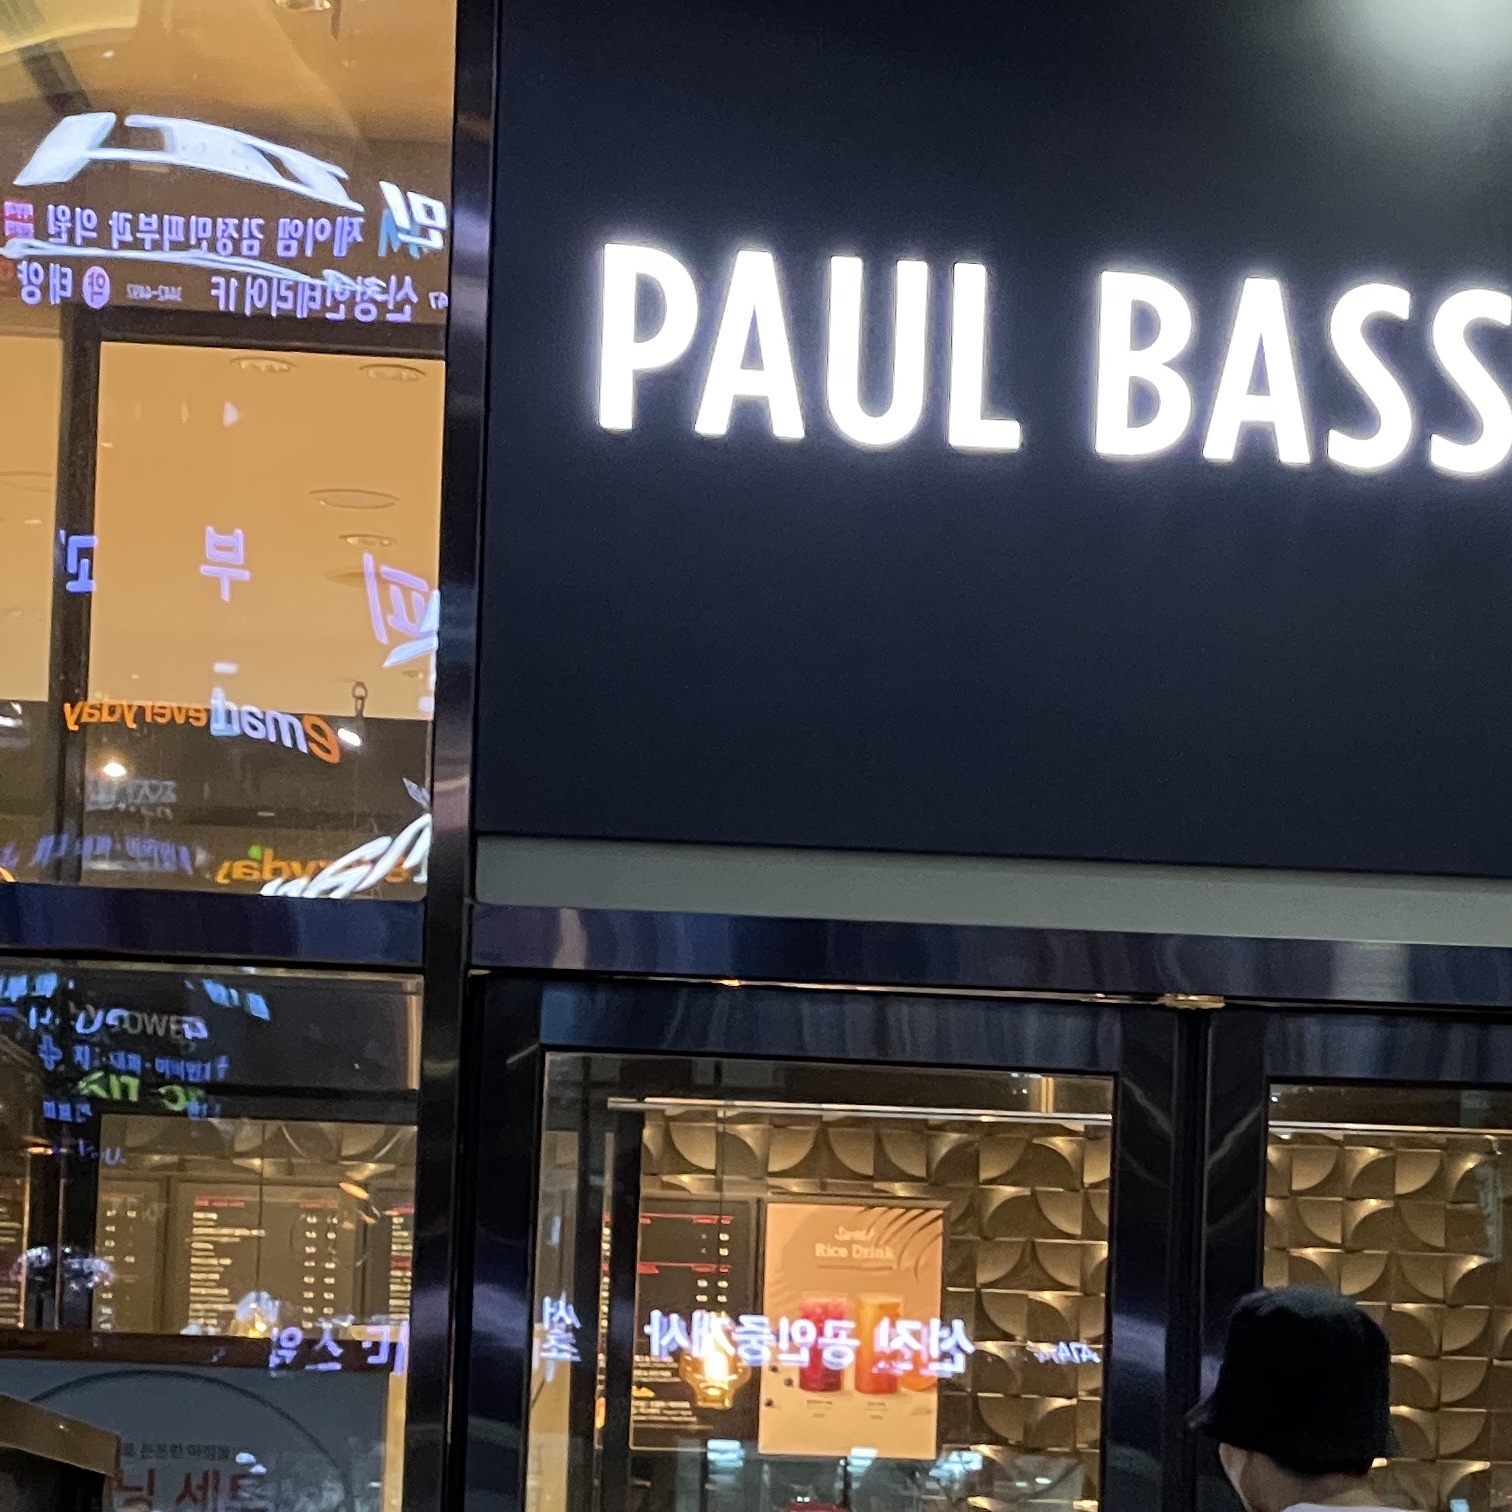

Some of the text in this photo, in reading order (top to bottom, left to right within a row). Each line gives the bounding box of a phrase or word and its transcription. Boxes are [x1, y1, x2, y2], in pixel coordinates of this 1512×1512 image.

[598, 240, 1021, 451] PAUL
[814, 1243, 896, 1260] Rice Drink
